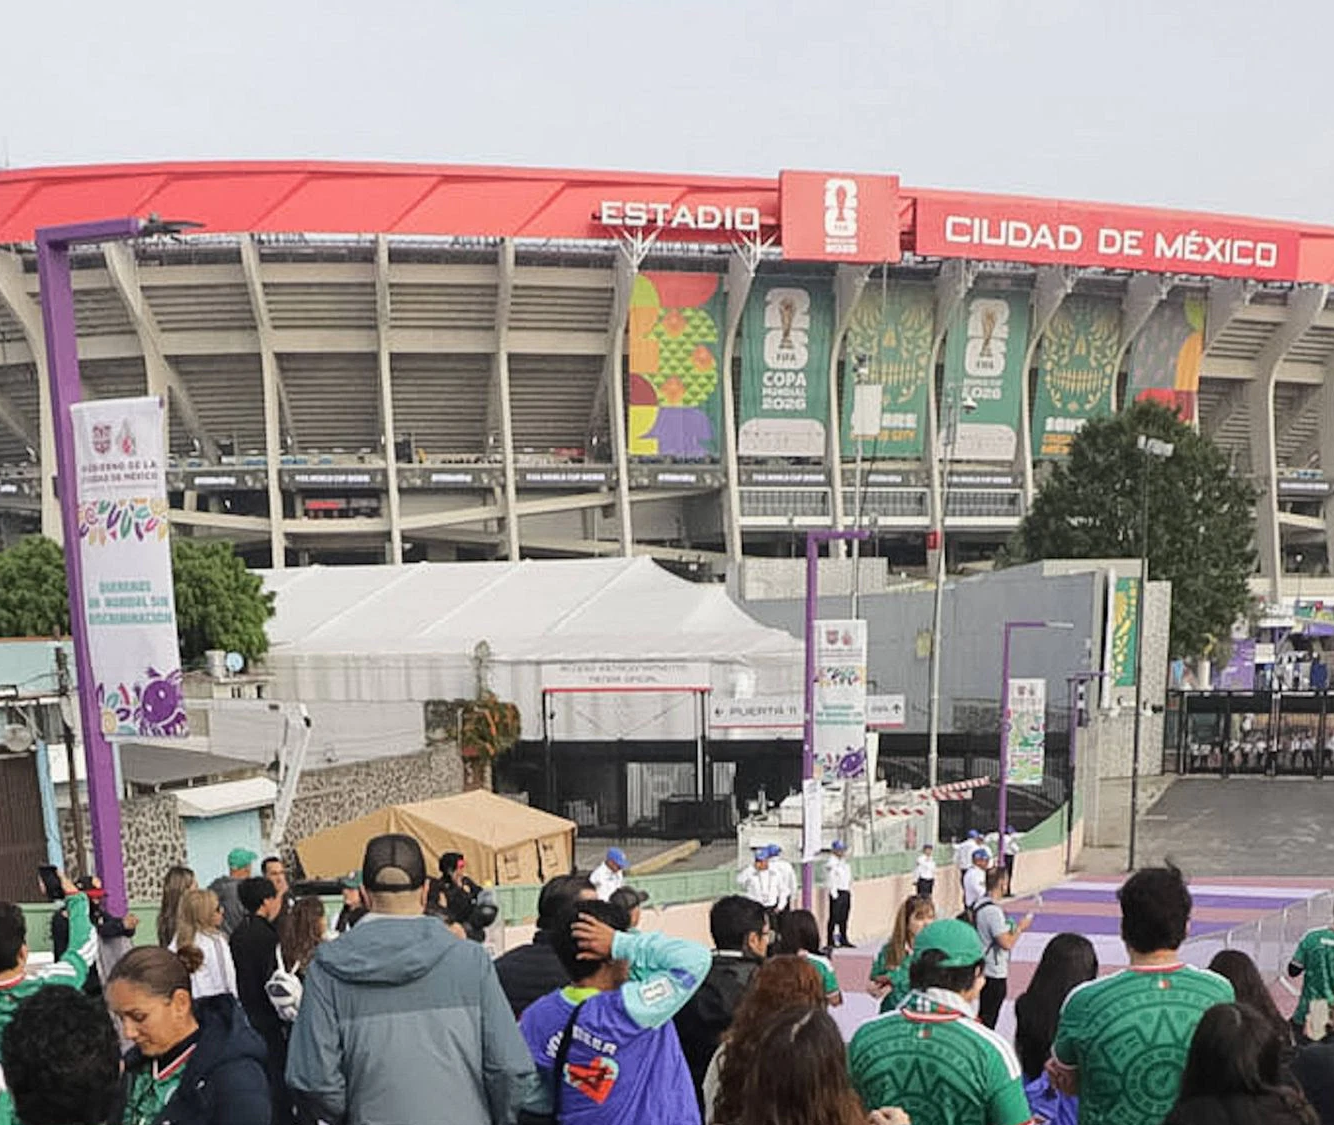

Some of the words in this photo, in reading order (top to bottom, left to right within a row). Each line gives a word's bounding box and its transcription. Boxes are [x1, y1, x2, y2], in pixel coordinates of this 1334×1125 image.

[600, 201, 760, 230] ESTADIO
[945, 215, 1082, 250] CIUDAD
[1098, 228, 1143, 256] DE
[1155, 230, 1277, 267] MÉXICO
[763, 371, 806, 386] COPA
[762, 397, 806, 410] 2026
